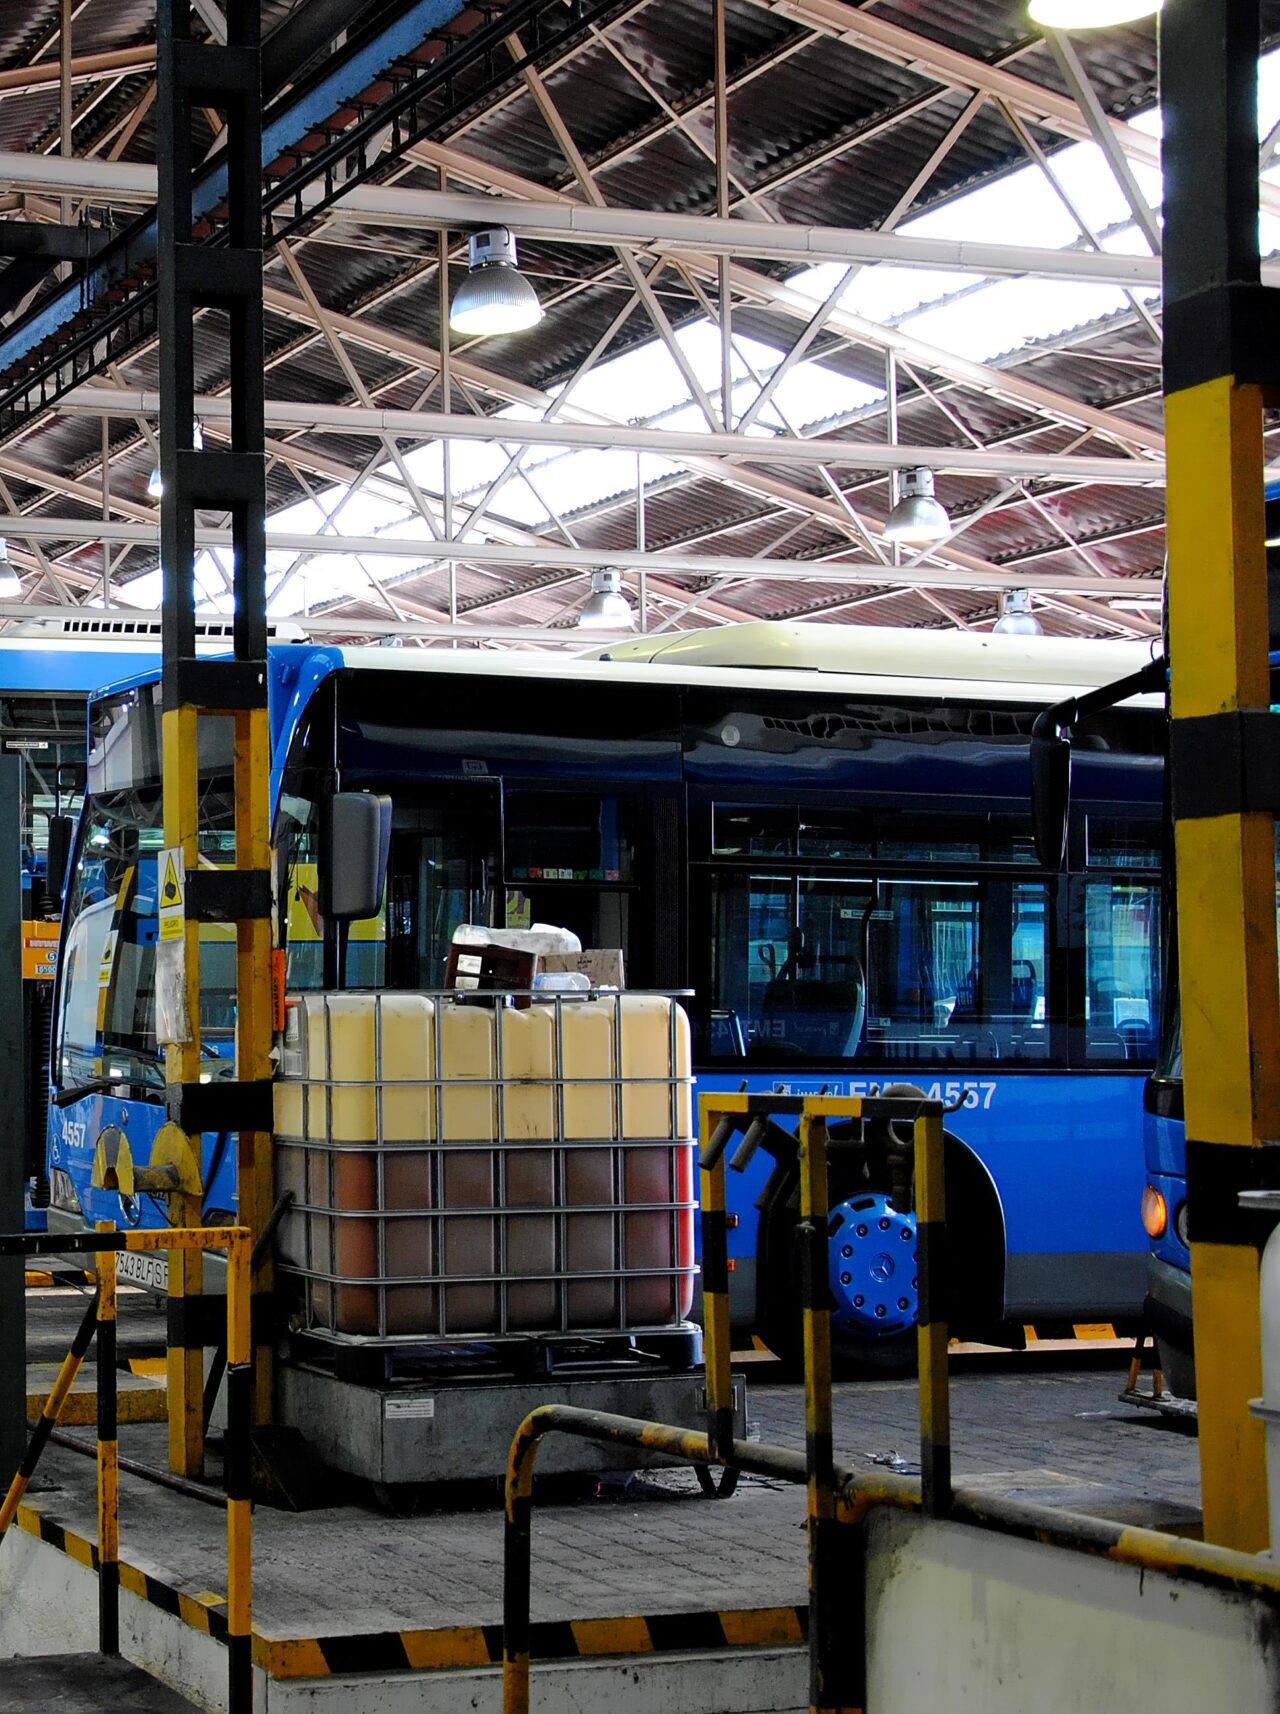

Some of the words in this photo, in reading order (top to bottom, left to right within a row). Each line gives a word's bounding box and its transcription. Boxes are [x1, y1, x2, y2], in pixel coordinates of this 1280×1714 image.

[928, 1082, 996, 1109] 4557
[62, 1120, 86, 1149] 4557
[116, 1252, 135, 1276] 7543
[136, 1258, 153, 1281] BLF
